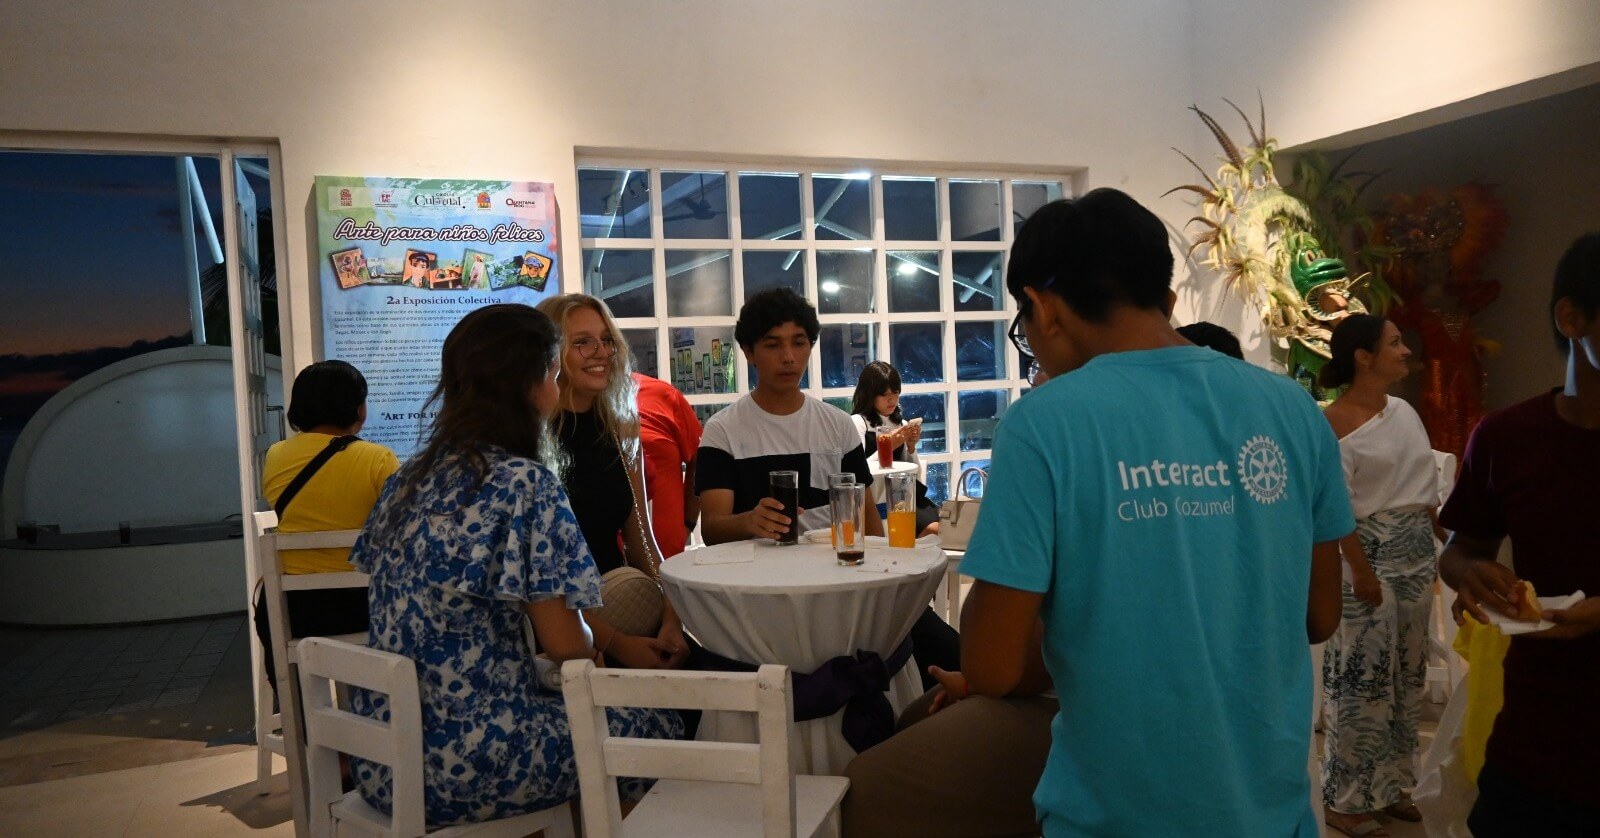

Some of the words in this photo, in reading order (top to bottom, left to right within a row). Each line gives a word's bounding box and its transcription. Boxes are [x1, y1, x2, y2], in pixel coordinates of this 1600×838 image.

[334, 218, 384, 240] Arte
[381, 226, 438, 246] para
[438, 224, 489, 242] niños
[488, 222, 545, 245] felices
[387, 296, 400, 304] 2a
[404, 296, 456, 306] Exposición
[458, 296, 502, 304] Colectiva
[1118, 460, 1230, 490] Interact
[1118, 497, 1168, 521] Club
[1175, 494, 1234, 516] Cozumel
